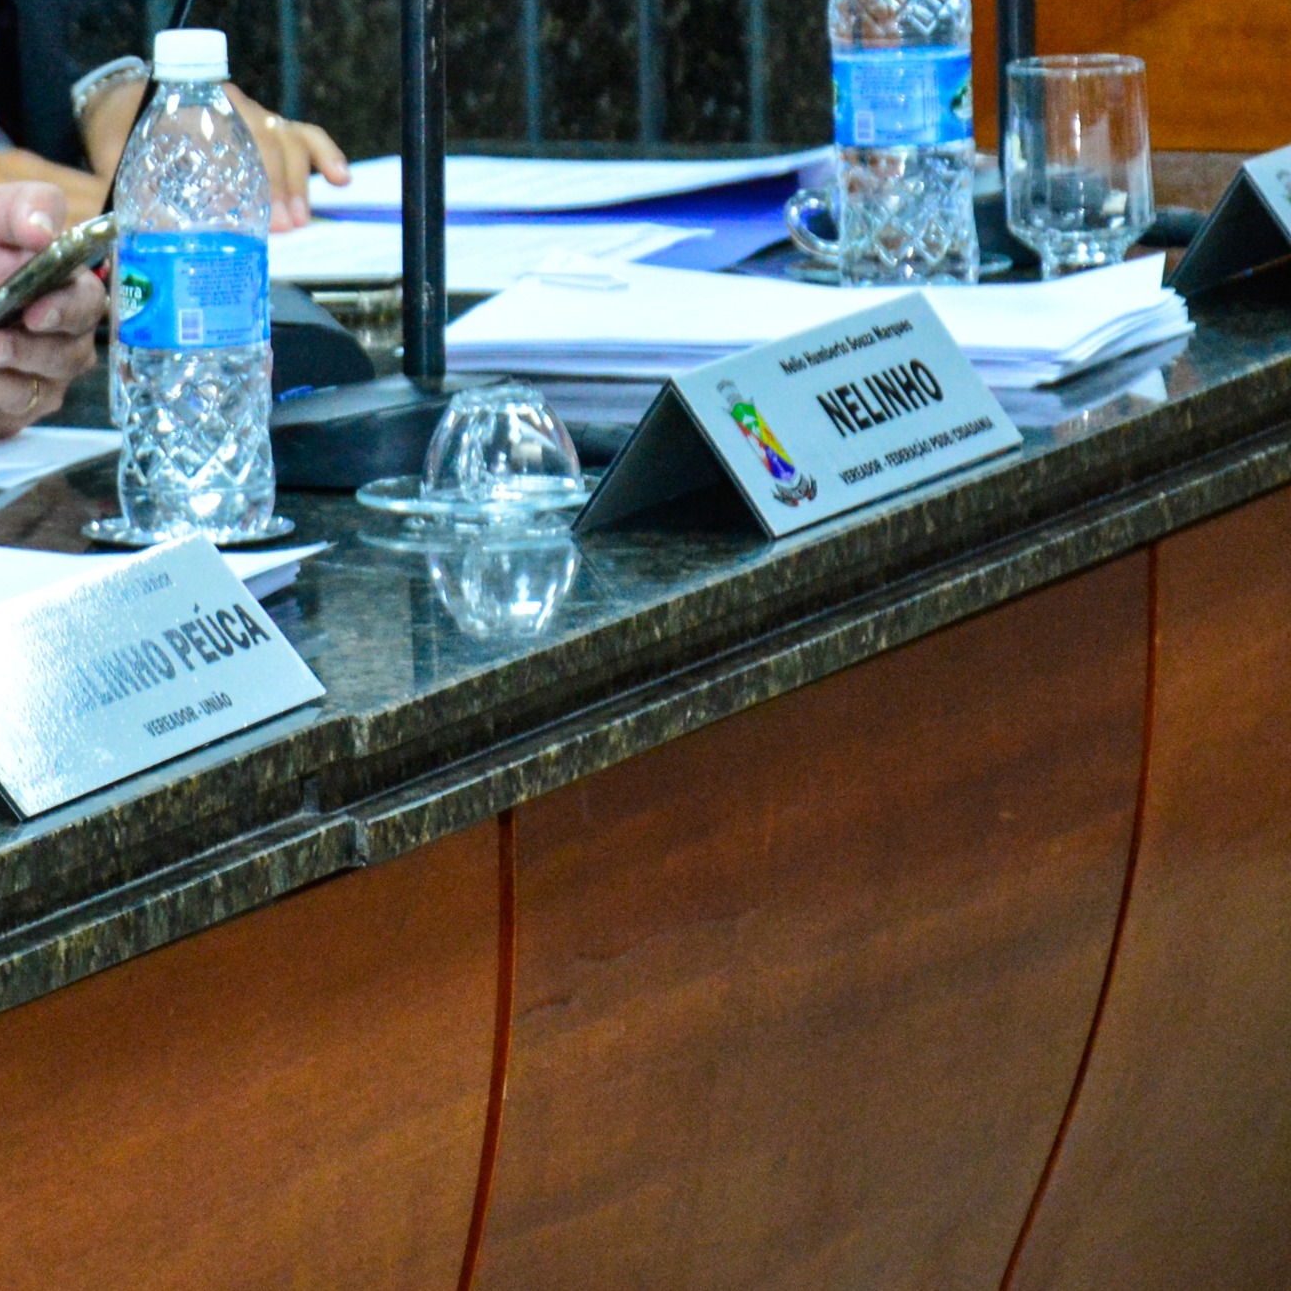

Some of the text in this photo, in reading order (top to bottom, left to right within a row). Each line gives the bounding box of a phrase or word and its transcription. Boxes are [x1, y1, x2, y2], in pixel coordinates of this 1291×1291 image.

[803, 341, 849, 366] Humberto
[845, 332, 876, 351] Souza
[871, 319, 913, 341] Marques
[816, 359, 944, 438] NELINHO
[839, 458, 885, 485] VEREADOR
[162, 602, 271, 671] PEÚCA
[143, 706, 199, 738] VEREADOR
[199, 691, 234, 716] UNIÃO
